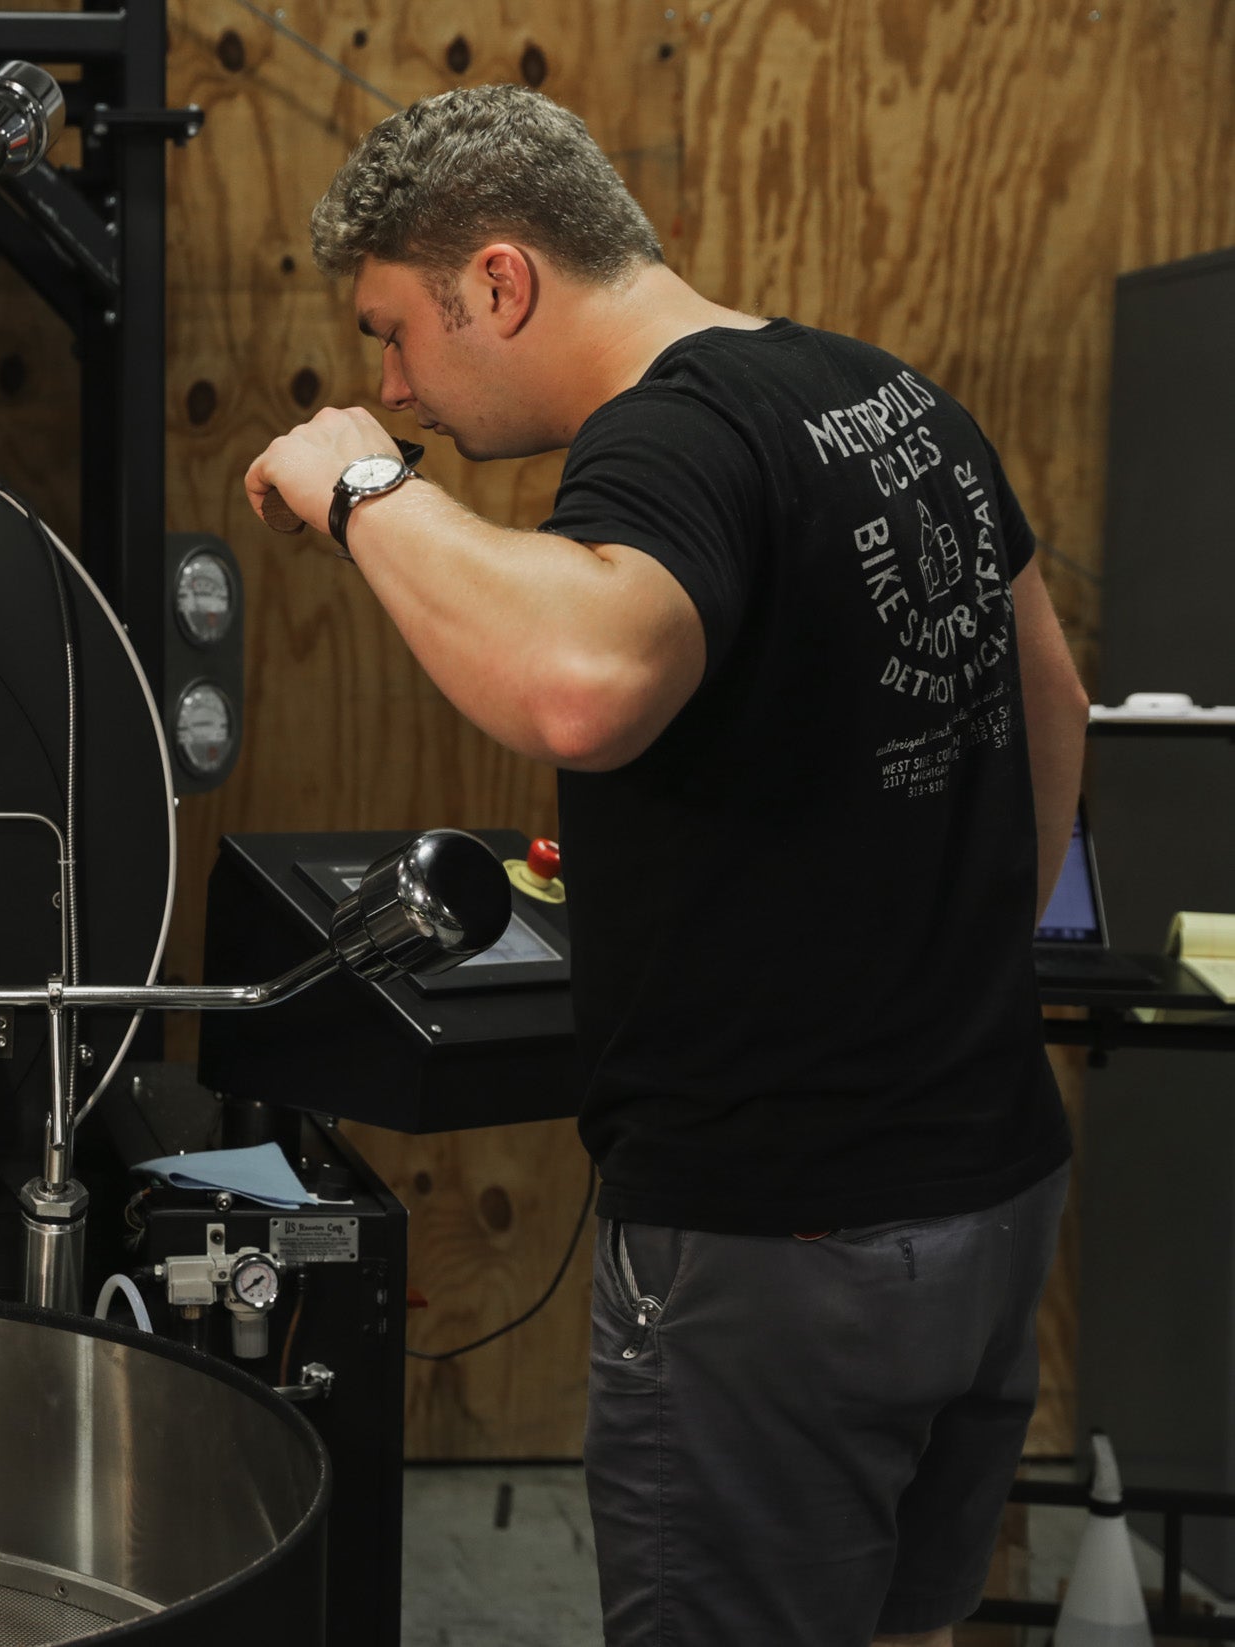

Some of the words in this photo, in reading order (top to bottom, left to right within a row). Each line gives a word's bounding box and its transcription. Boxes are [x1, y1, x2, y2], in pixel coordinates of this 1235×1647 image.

[854, 516, 909, 623] BIKE
[876, 733, 927, 757] authorized
[882, 759, 911, 776] WEST
[883, 773, 906, 789] 2117
